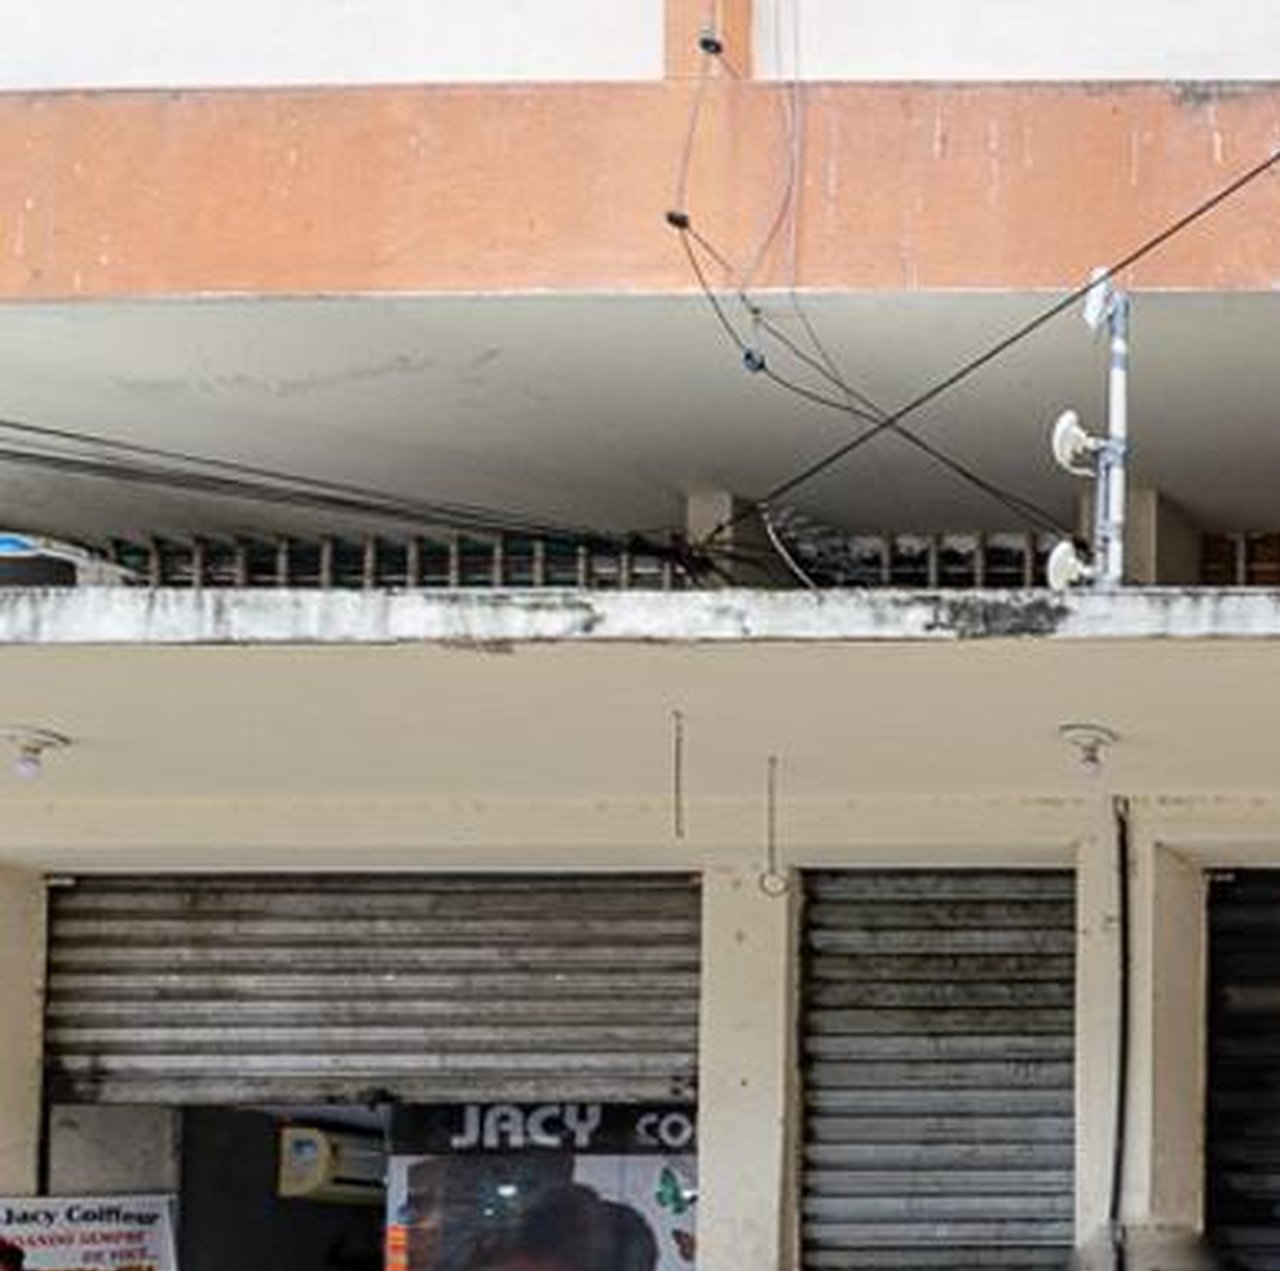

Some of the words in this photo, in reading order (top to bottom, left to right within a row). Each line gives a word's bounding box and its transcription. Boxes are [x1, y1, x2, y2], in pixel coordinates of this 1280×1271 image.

[451, 1103, 600, 1148] JACY
[2, 1207, 57, 1227] Jacy
[66, 1204, 161, 1225] Coiffeur
